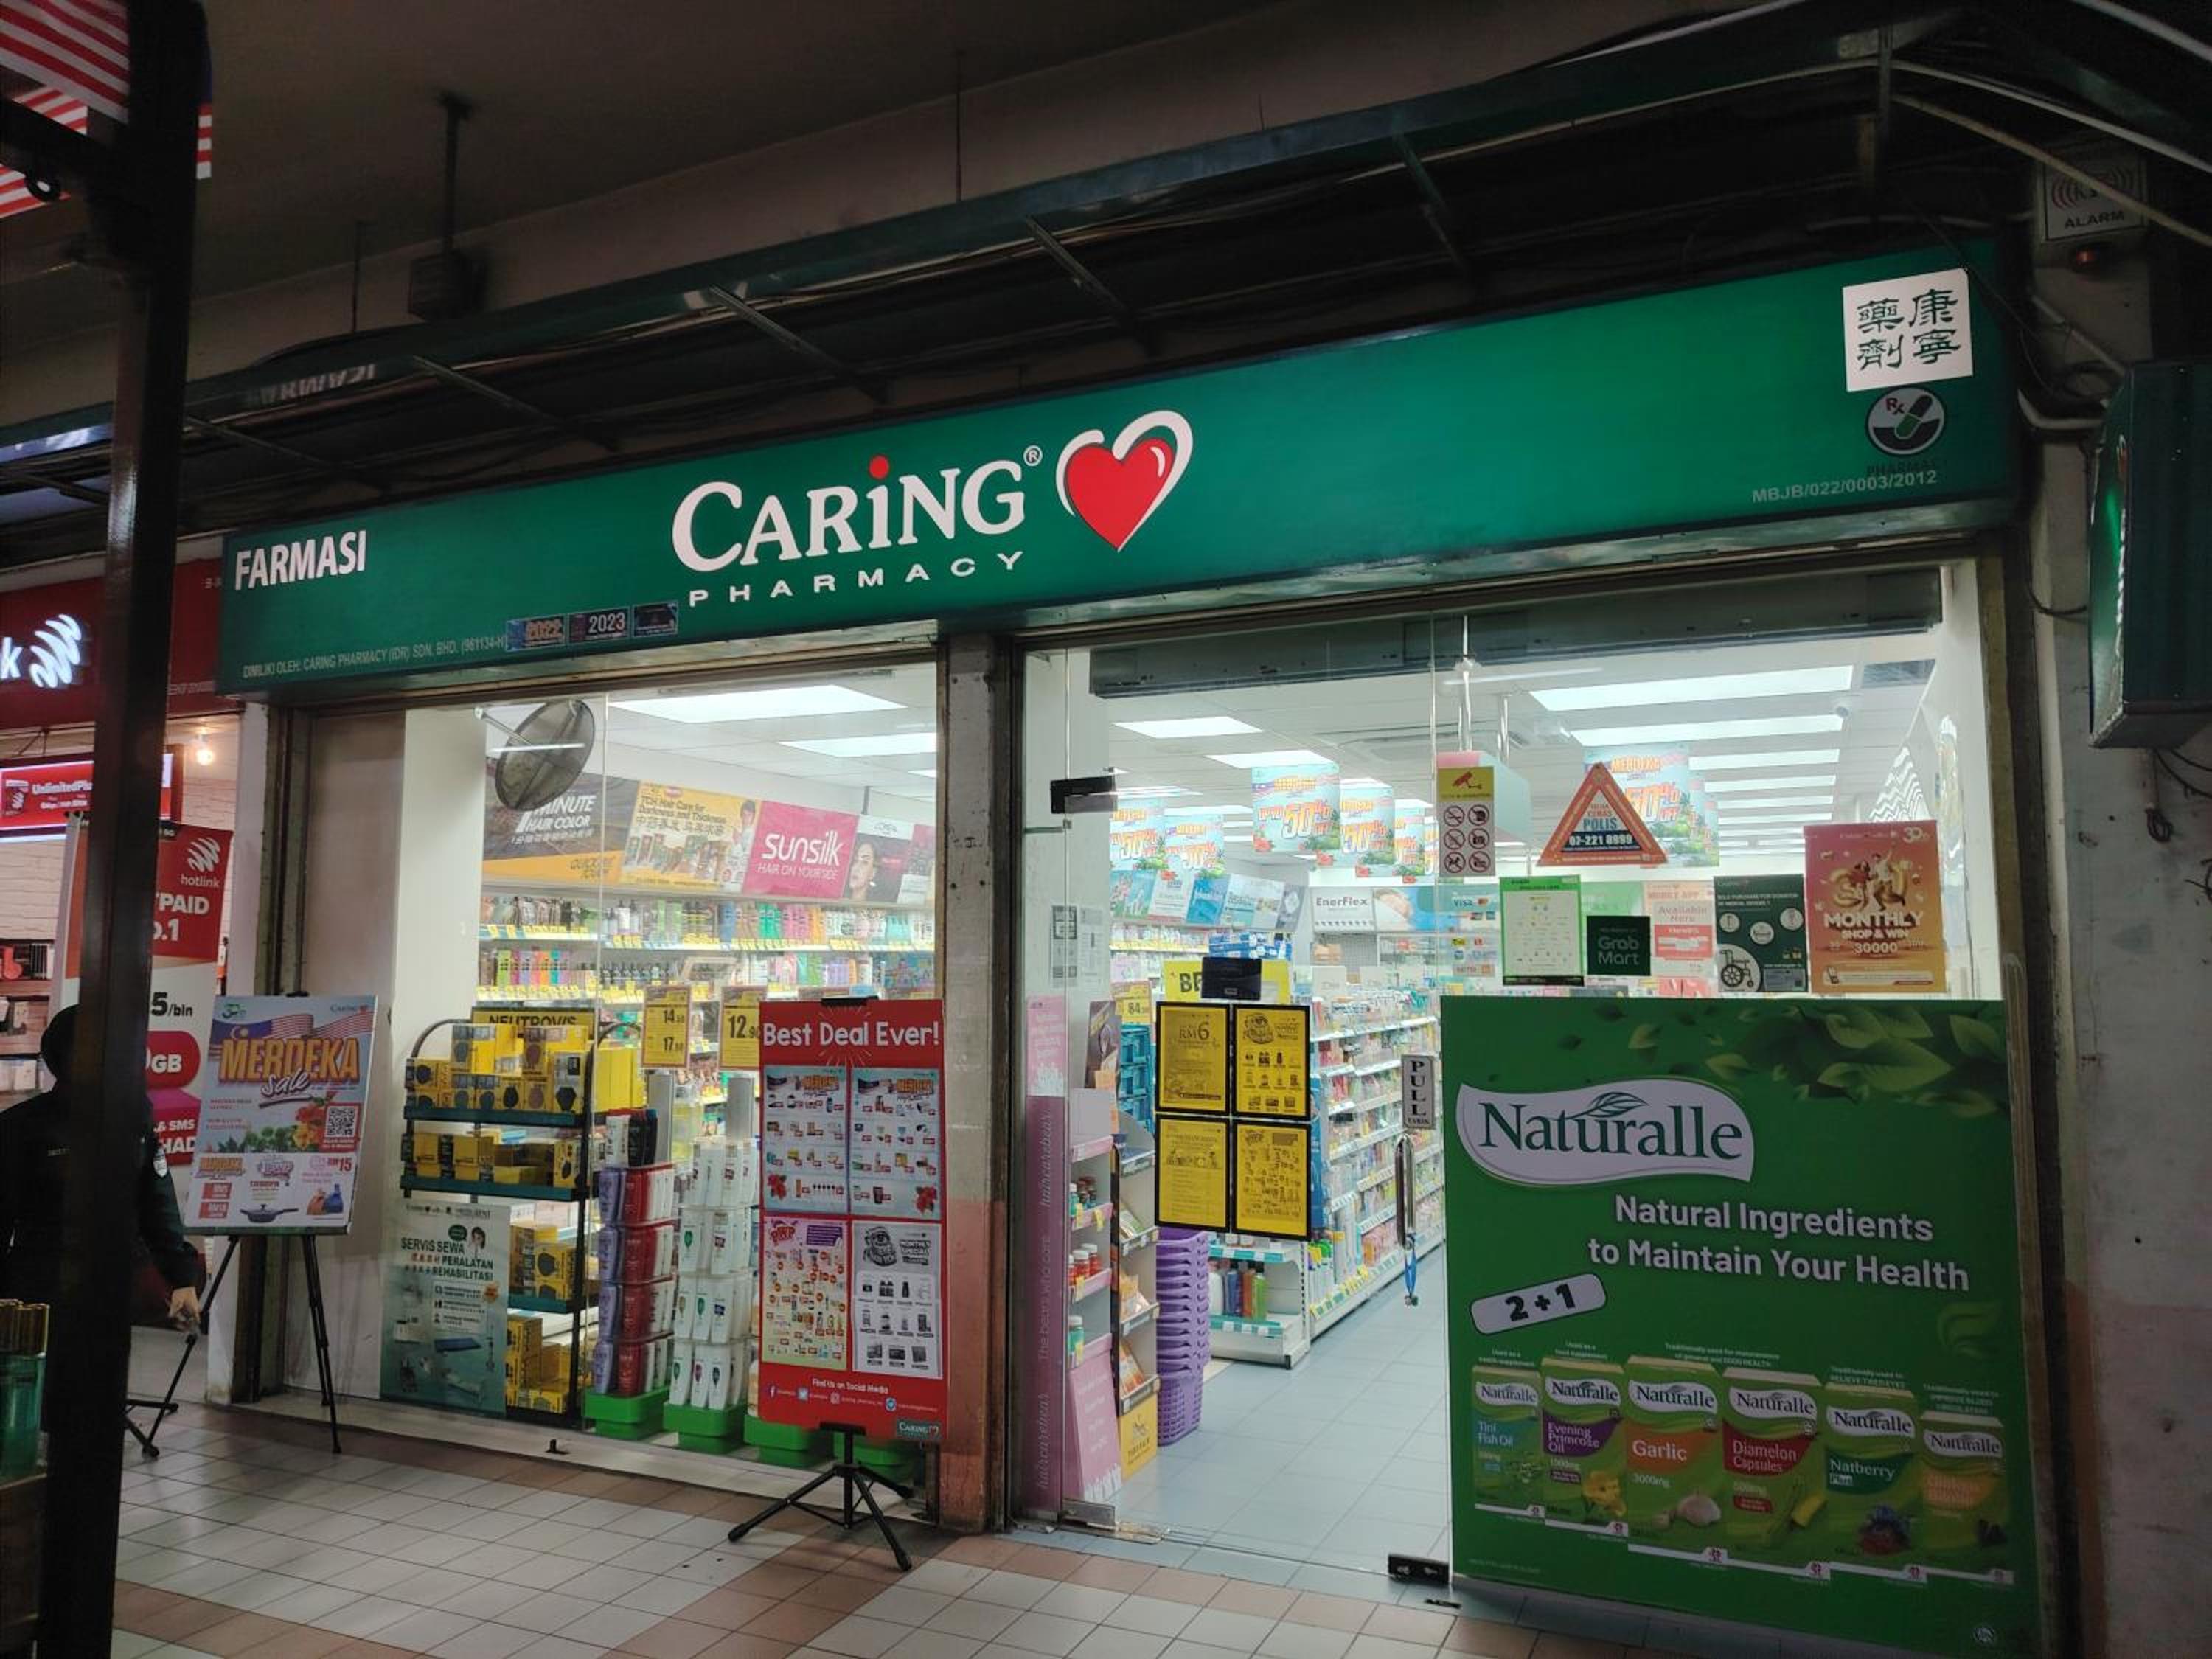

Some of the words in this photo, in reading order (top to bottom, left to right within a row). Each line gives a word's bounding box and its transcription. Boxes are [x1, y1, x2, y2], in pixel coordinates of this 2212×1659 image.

[2065, 211, 2124, 229] ALARM
[235, 529, 367, 590] FARMASI
[689, 550, 1024, 608] PHARMACY
[589, 612, 625, 633] 2023
[338, 648, 388, 667] PHARMACY
[527, 817, 554, 832] HAIR
[554, 815, 591, 830] COLOR
[1583, 818, 1618, 830] POLIS
[757, 863, 780, 875] HAIR
[782, 866, 796, 876] ON
[181, 874, 220, 888] hotlink
[1315, 896, 1368, 907] EnerFlex
[1453, 899, 1473, 908] VISA
[1823, 911, 1924, 928] MONTHLY
[1597, 935, 1640, 950] Grab
[1841, 929, 1874, 940] SHOP
[1886, 929, 1910, 939] WIN
[1854, 942, 1899, 954] 30000
[1597, 950, 1640, 965] Mart
[763, 1022, 812, 1046] Best
[819, 1021, 869, 1046] Deal
[876, 1020, 940, 1046] Ever!
[219, 1037, 359, 1083] MERDEKA
[261, 1070, 309, 1097] sale
[1410, 1060, 1427, 1116] PULL
[169, 1119, 195, 1132] SMS
[1478, 1102, 1743, 1161] Naturalle
[1616, 1194, 1731, 1230] Natural
[1739, 1203, 1934, 1242] Ingredients
[400, 1237, 436, 1251] SERVIS
[437, 1241, 465, 1255] SEWA
[442, 1256, 493, 1270] PERALATAN
[1587, 1237, 1621, 1263] to
[1628, 1239, 1762, 1276] Maintain
[1770, 1250, 1846, 1283] Your
[1856, 1256, 1969, 1292] Health
[433, 1267, 493, 1281] REHABILITASI
[1504, 1283, 1576, 1322] 2+1
[1481, 1385, 1537, 1402] Naturalle
[1551, 1381, 1618, 1402] Naturalle
[1636, 1385, 1715, 1409] Naturalle
[1737, 1391, 1815, 1414] Naturalle
[1548, 1421, 1592, 1440] Evening
[1834, 1411, 1913, 1435] Naturalle
[1478, 1433, 1500, 1445] Fish
[1548, 1434, 1600, 1450] Primrose
[1548, 1440, 1565, 1455] Oil
[1930, 1433, 2000, 1455] Naturalle
[1632, 1439, 1688, 1462] Garlic
[1733, 1439, 1797, 1462] Diamelon
[1733, 1455, 1783, 1472] Capsules
[1829, 1457, 1896, 1481] Natberry
